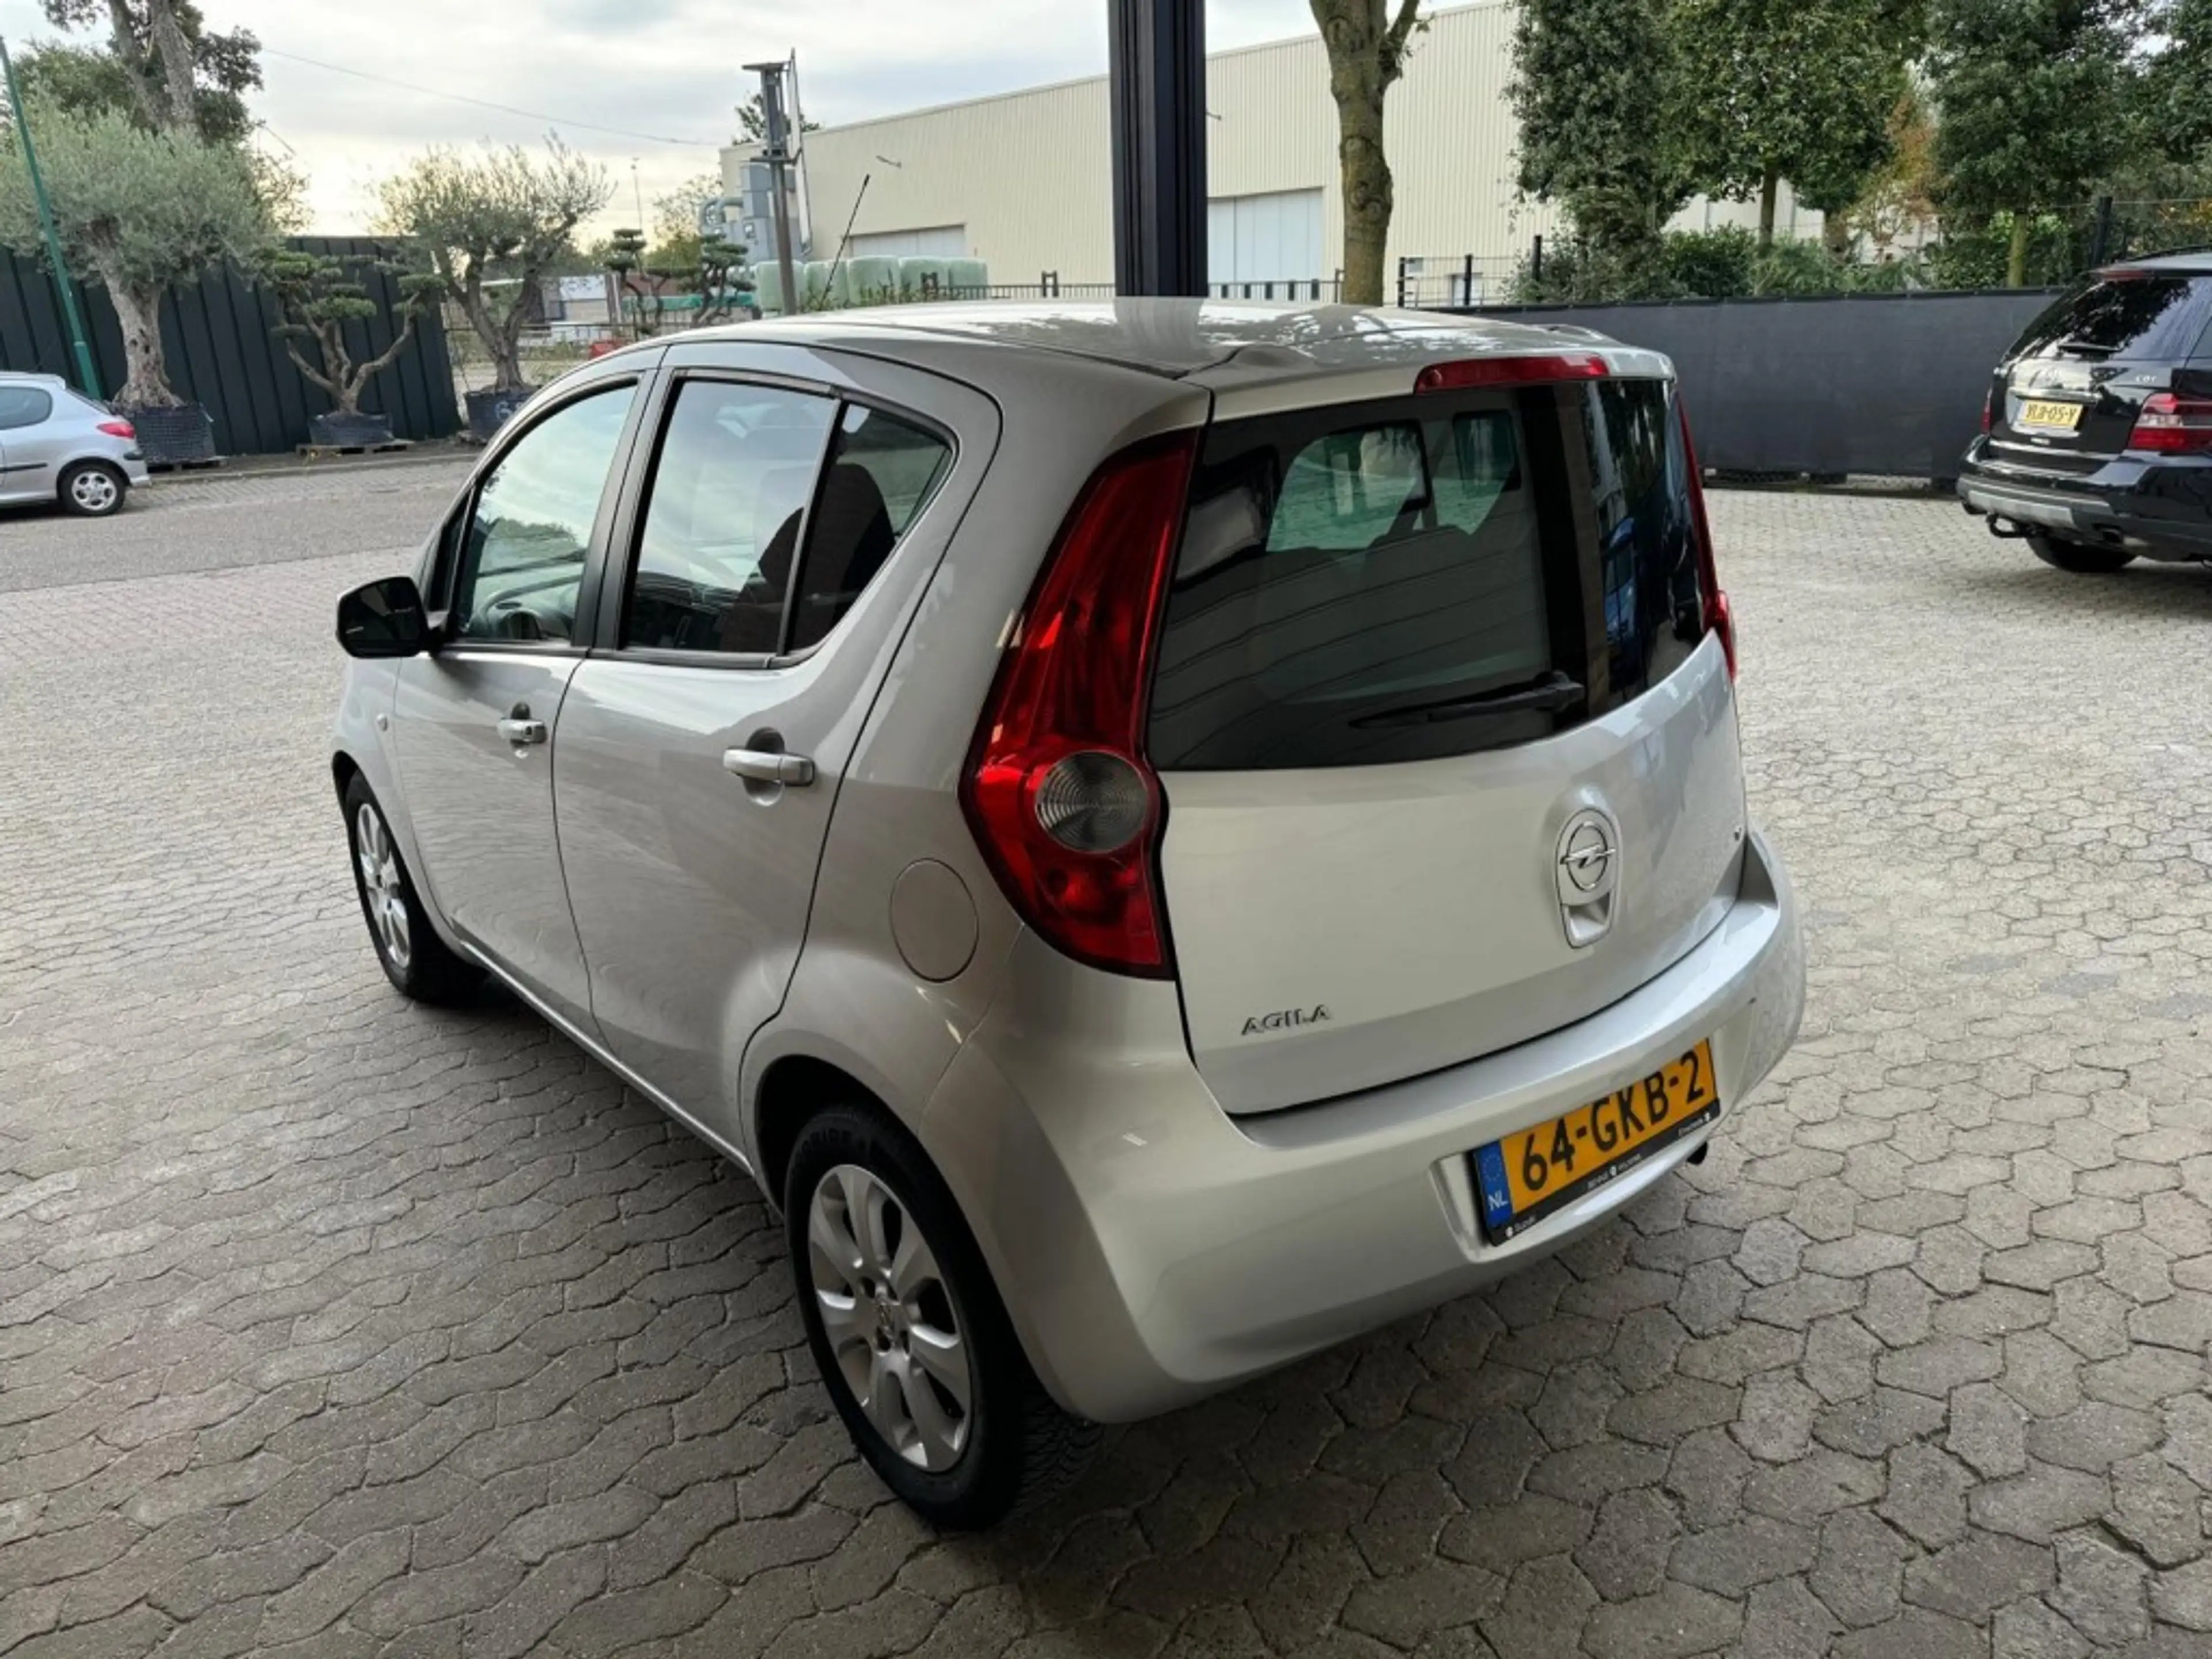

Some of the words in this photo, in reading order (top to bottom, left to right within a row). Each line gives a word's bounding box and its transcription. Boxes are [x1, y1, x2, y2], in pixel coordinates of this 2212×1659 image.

[1241, 1004, 1331, 1036] AGILA
[1522, 1050, 1705, 1191] 64-GKB-2
[1487, 1189, 1509, 1211] NL
